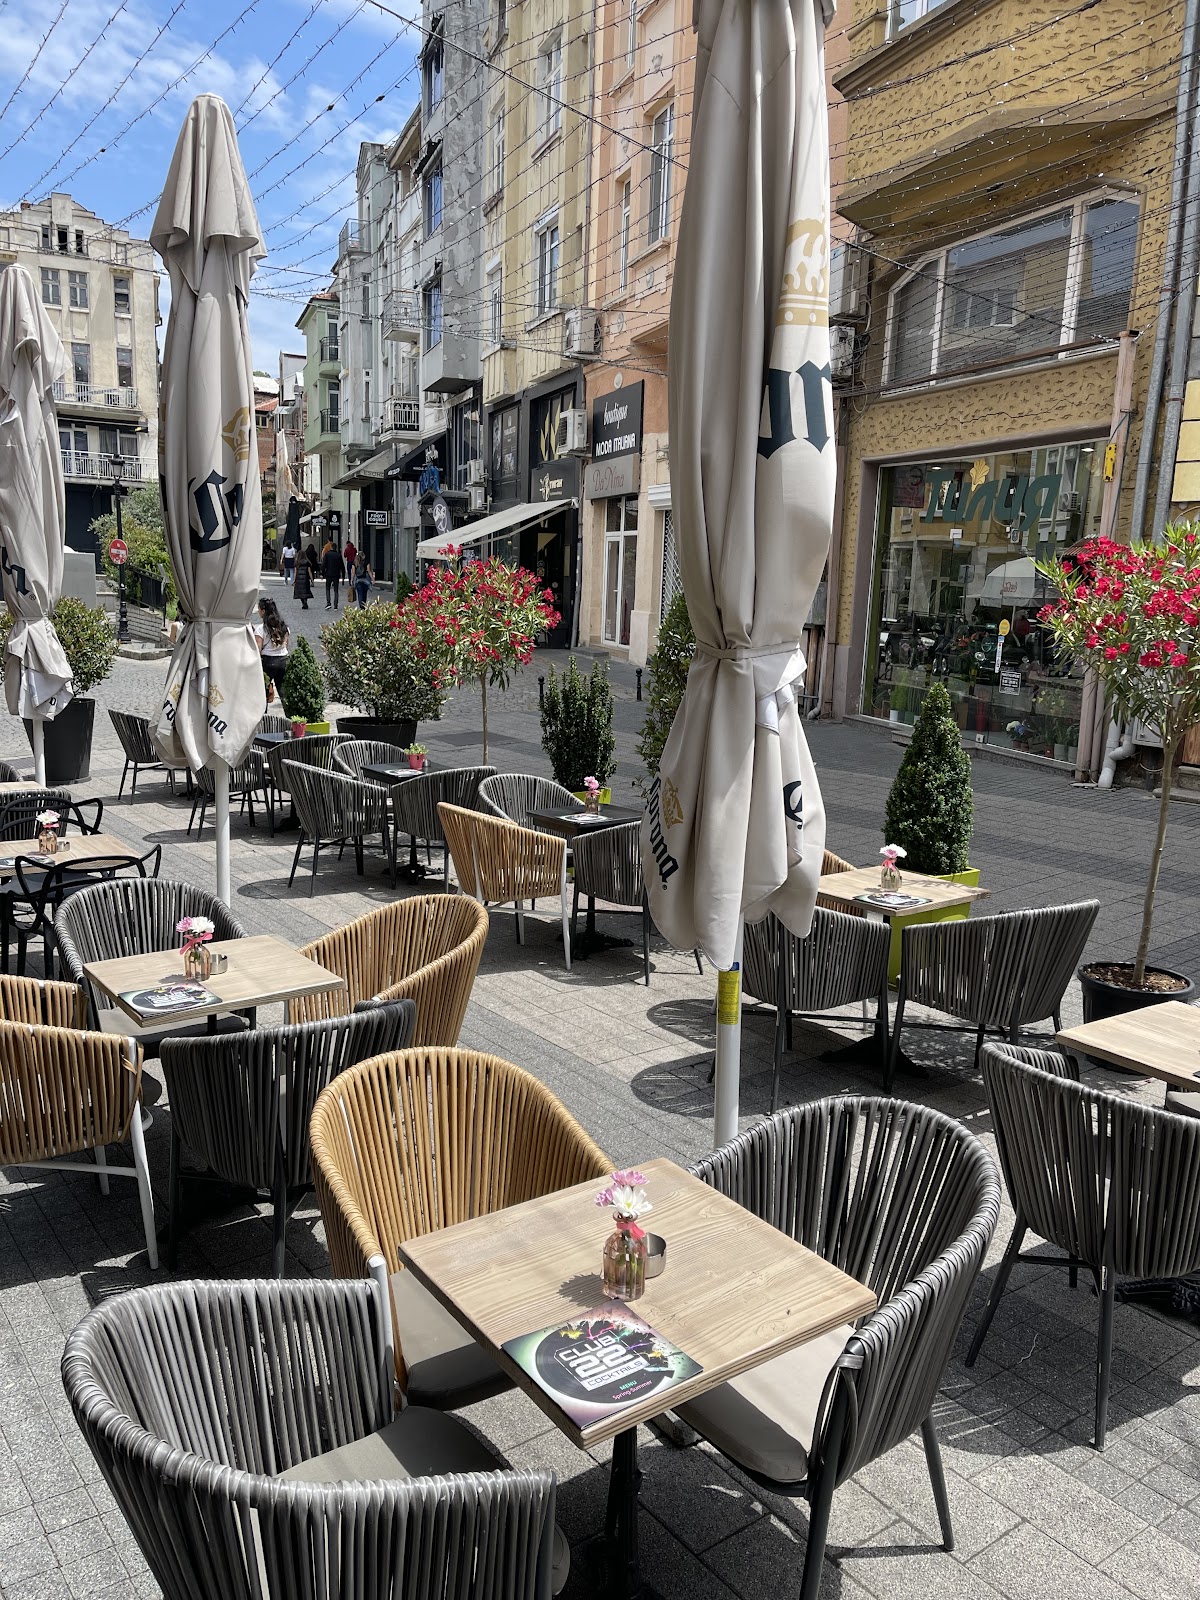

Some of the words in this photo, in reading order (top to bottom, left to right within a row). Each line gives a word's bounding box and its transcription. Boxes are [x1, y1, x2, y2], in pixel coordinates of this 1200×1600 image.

[595, 439, 612, 457] MODA
[559, 1336, 615, 1361] CLUB
[569, 1344, 634, 1378] 22
[587, 1360, 643, 1386] COCKTAILS
[619, 1380, 637, 1391] MENU
